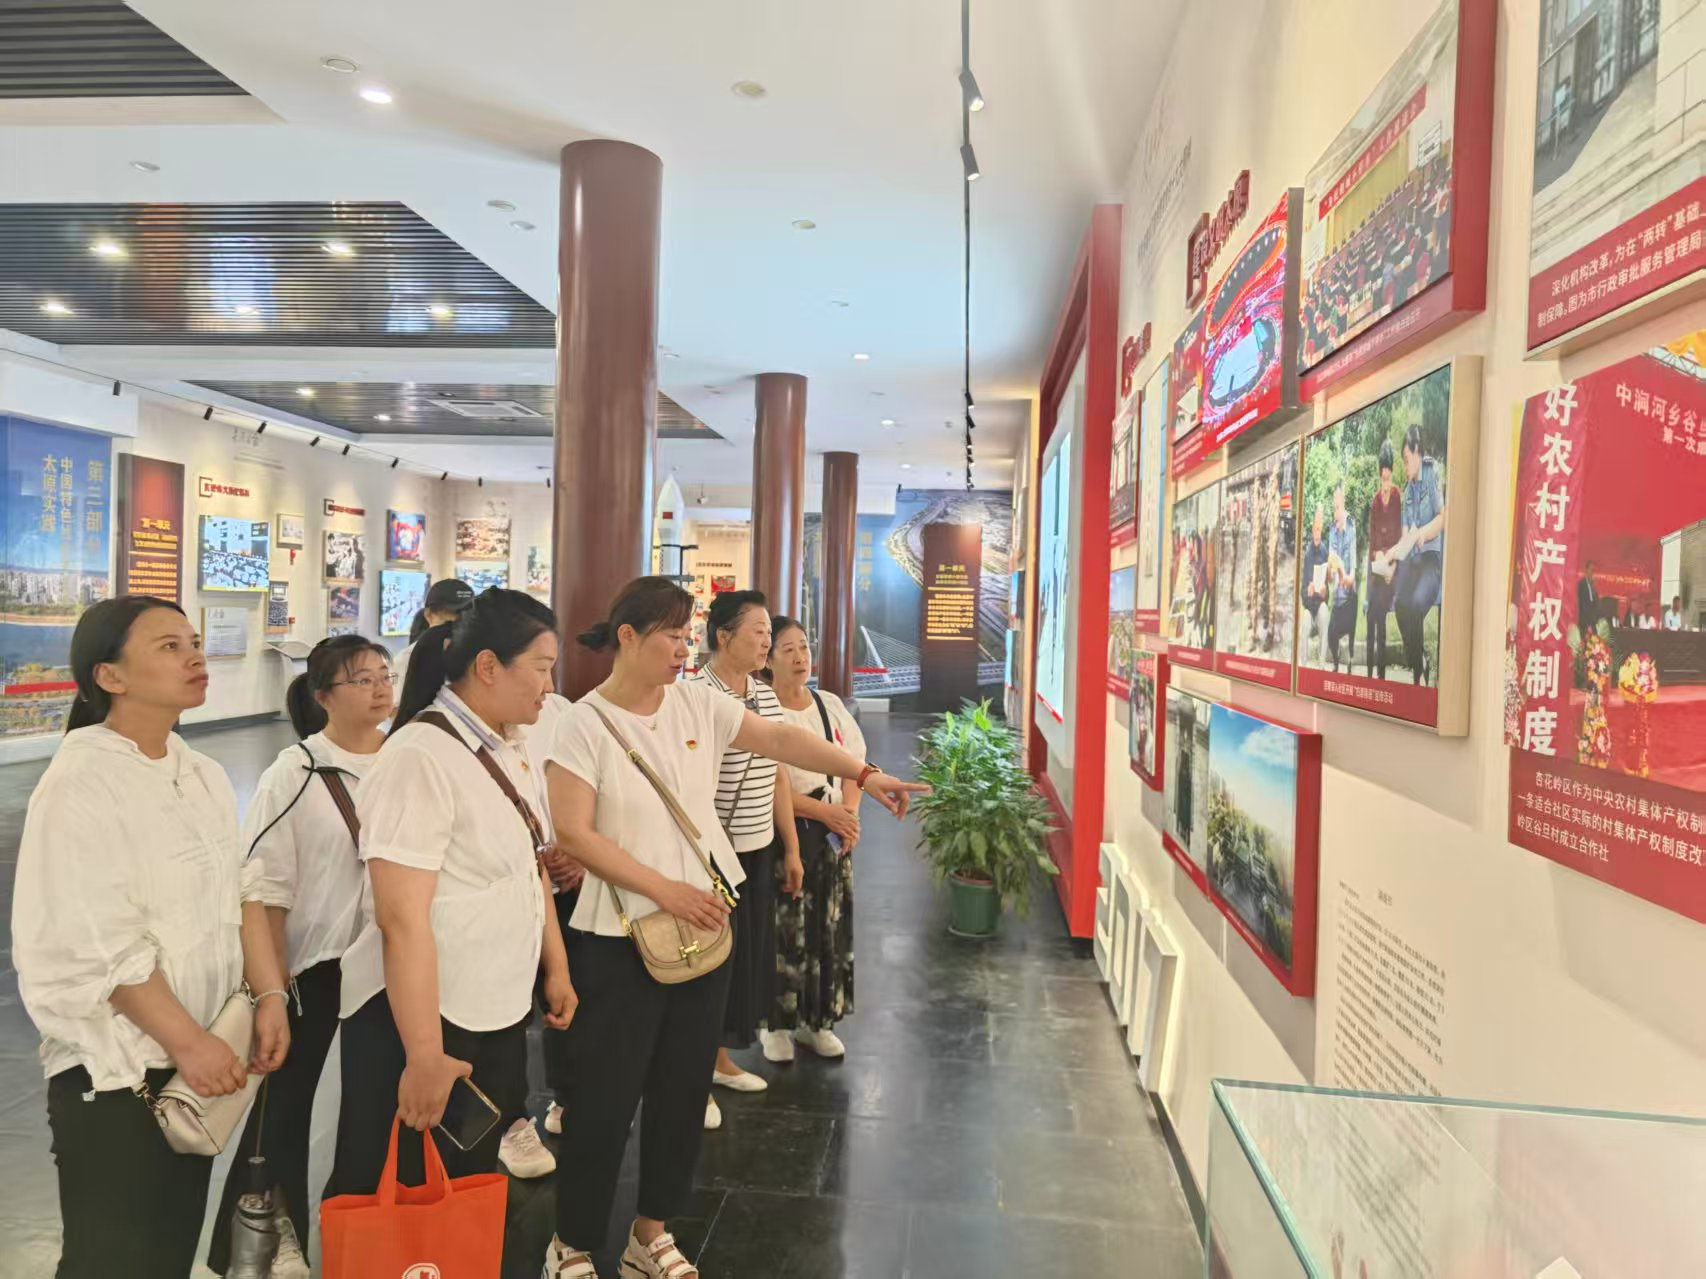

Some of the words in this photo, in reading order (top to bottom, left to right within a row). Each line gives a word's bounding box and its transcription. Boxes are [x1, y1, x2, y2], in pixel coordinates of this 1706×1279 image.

[1523, 383, 1578, 755] 好农村产权制度
[1517, 813, 1609, 862] 岭区谷旦村成立合作社
